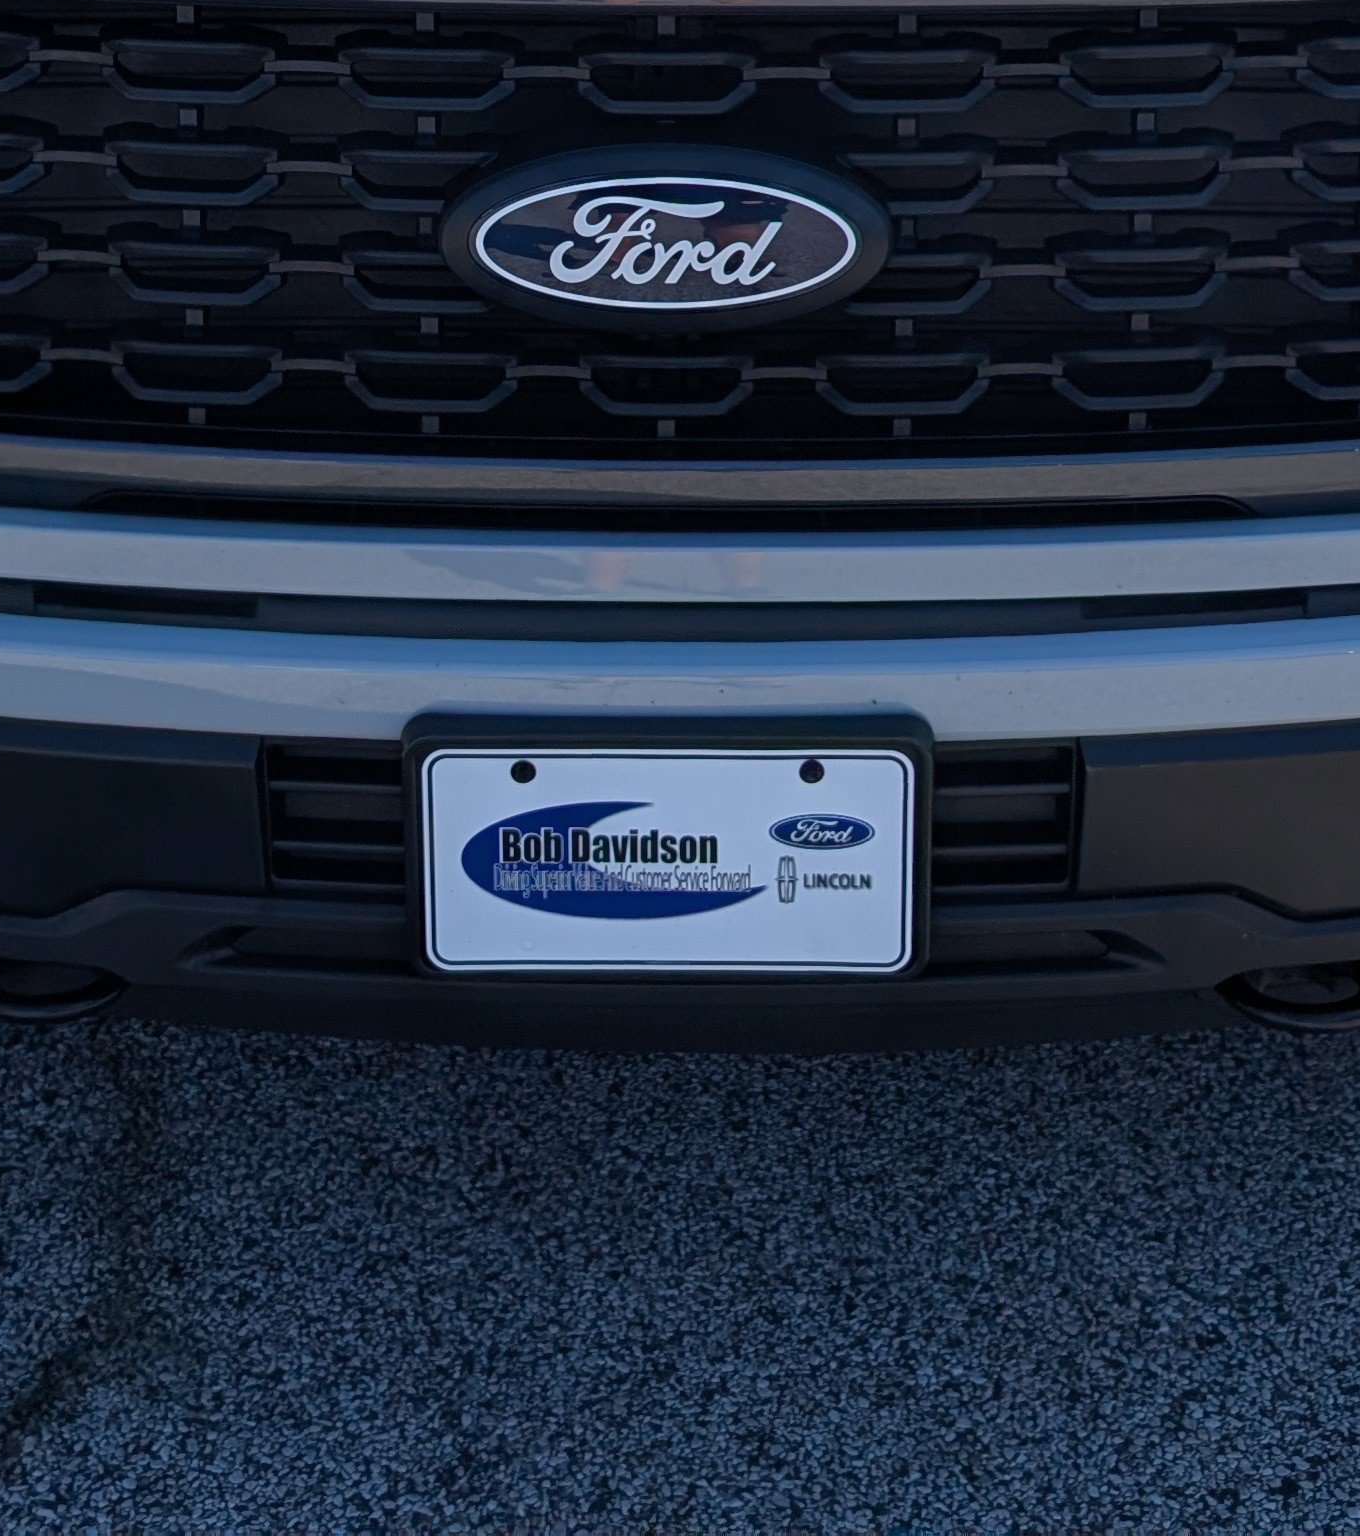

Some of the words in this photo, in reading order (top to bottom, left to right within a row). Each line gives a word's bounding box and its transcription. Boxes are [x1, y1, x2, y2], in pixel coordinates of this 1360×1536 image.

[549, 195, 783, 286] Ford
[499, 827, 564, 864] Bob
[569, 827, 718, 864] Davidson
[493, 862, 530, 898] Driving
[531, 862, 572, 898] Superior
[572, 862, 602, 892] Value
[602, 863, 624, 892] And
[625, 864, 673, 892] Customer
[674, 864, 710, 891] Service
[711, 864, 752, 892] Forward
[802, 873, 873, 890] LINCOLN
